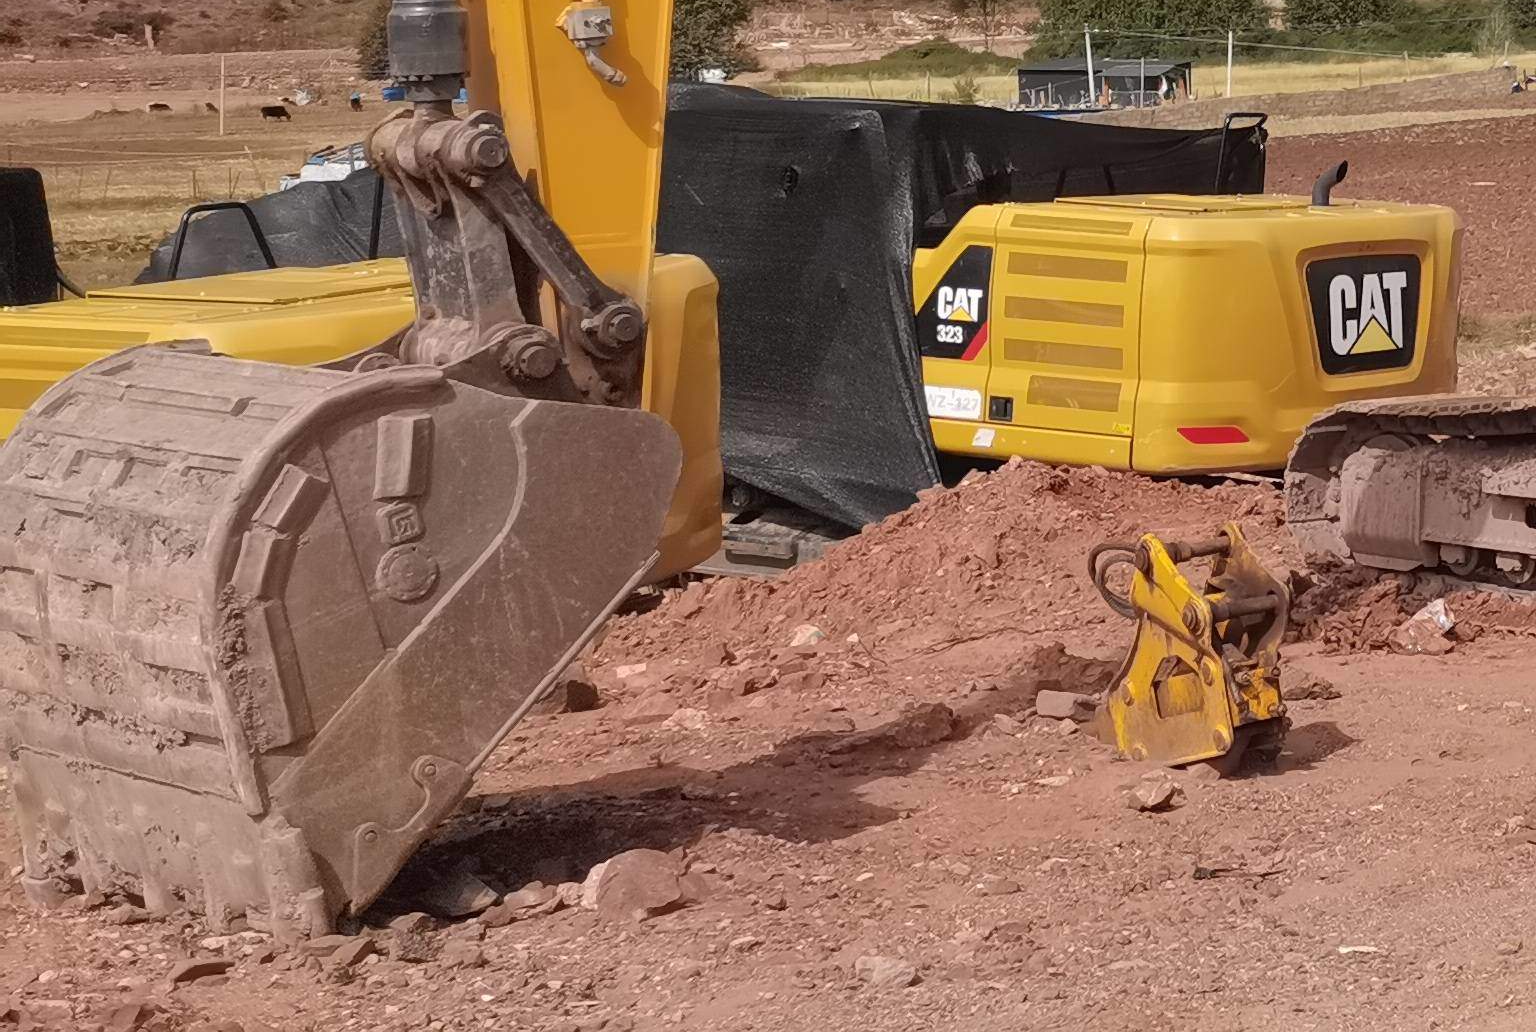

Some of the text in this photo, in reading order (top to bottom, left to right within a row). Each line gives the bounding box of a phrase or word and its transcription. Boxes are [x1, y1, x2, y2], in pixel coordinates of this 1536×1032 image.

[937, 286, 983, 323] CAT
[1329, 271, 1407, 355] CAT
[936, 325, 963, 343] 323
